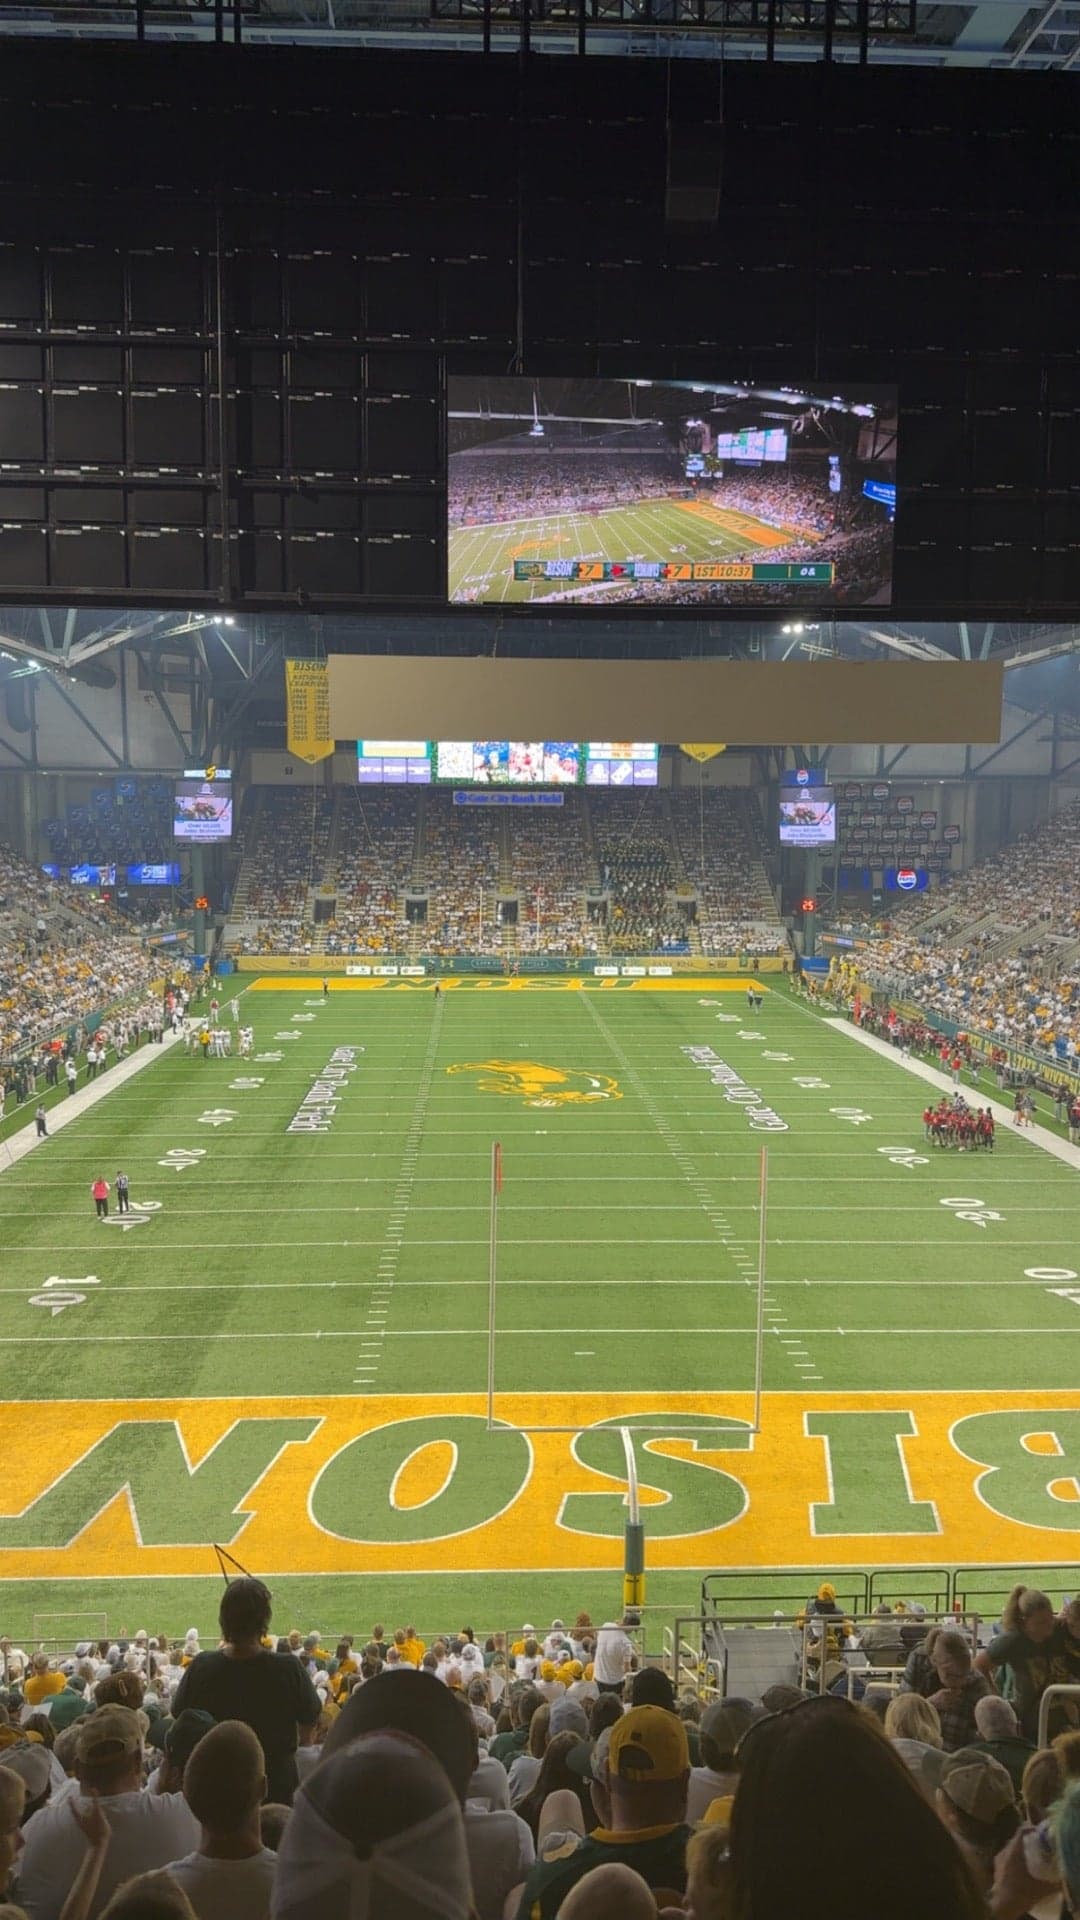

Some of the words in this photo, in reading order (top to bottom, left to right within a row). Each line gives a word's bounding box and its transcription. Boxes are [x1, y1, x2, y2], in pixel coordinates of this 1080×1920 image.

[546, 560, 573, 576] BISON
[584, 565, 594, 577] 7
[673, 565, 683, 577] 7
[696, 566, 716, 577] 1ST
[720, 566, 750, 577] 10:37
[294, 662, 327, 671] BISON
[195, 897, 208, 908] 25
[370, 977, 642, 992] NDSU
[722, 1085, 763, 1104] City
[745, 1105, 790, 1131] Gate
[157, 1148, 207, 1167] 30
[877, 1146, 930, 1165] 30
[939, 1197, 1007, 1222] 20
[28, 1275, 101, 1307] 10
[0, 1408, 1080, 1550] BISON
